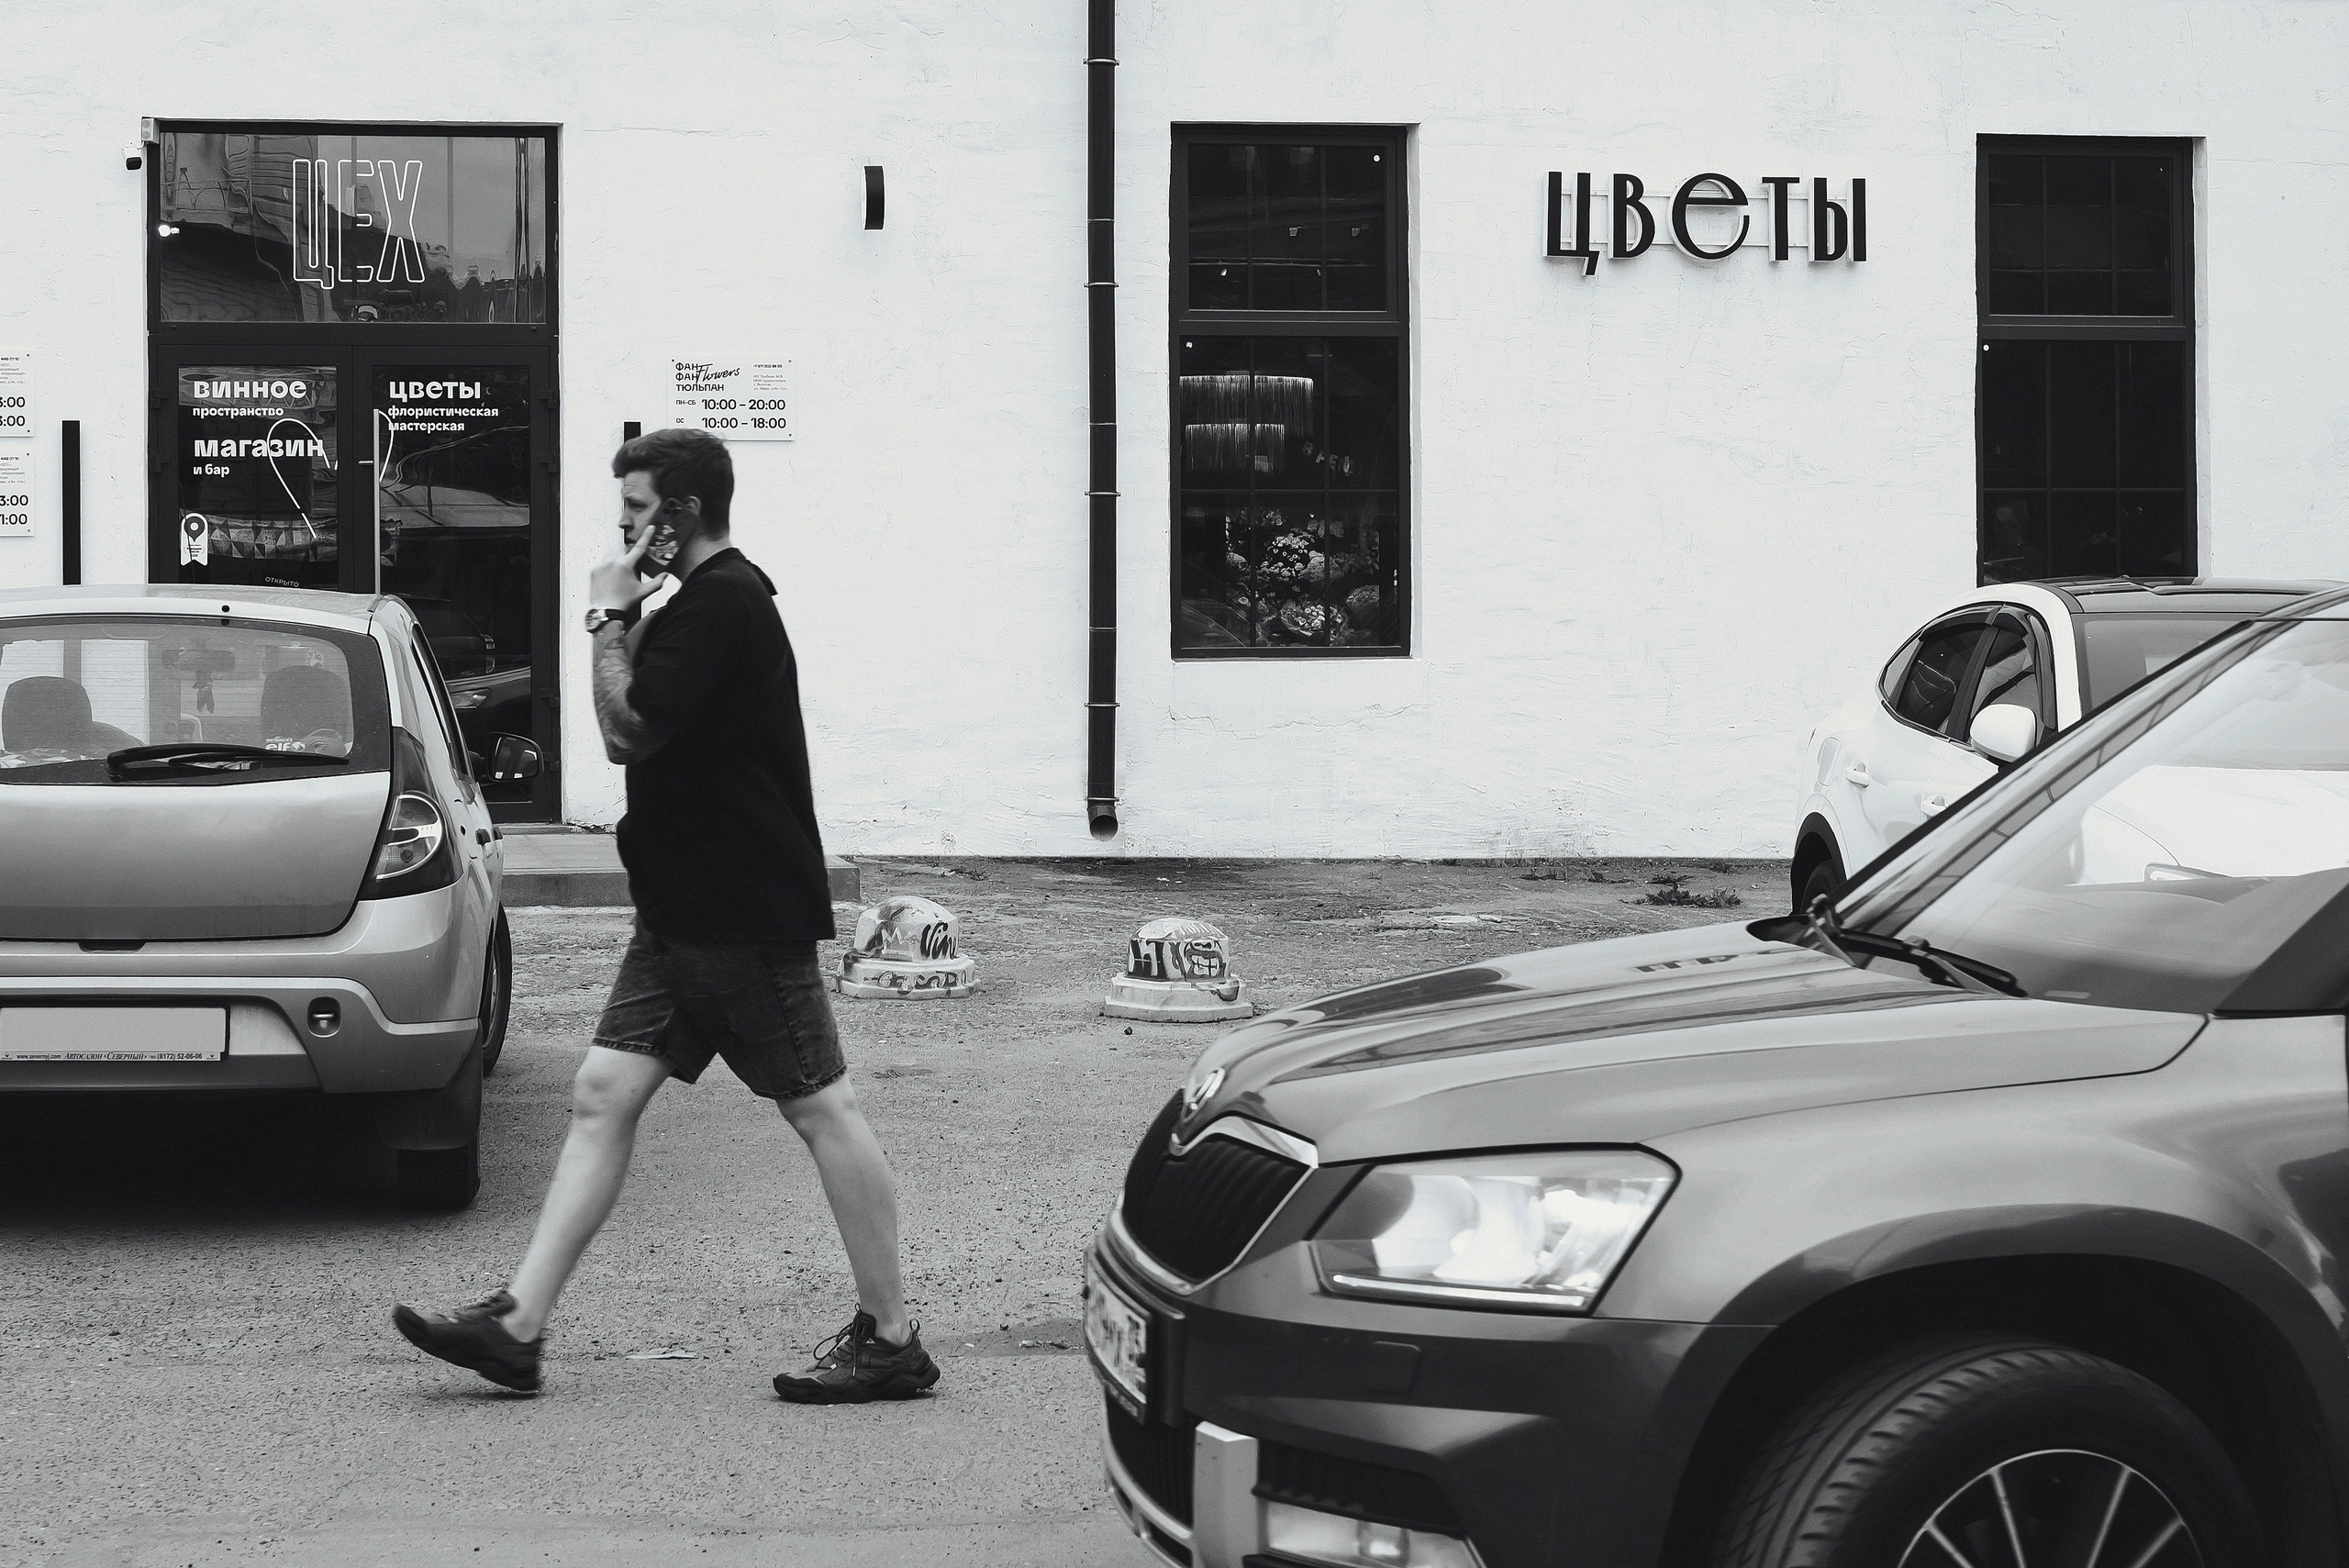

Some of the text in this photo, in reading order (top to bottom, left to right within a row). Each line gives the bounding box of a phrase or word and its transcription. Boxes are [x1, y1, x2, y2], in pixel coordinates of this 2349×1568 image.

[293, 159, 425, 289] ЦЕХ
[696, 363, 740, 384] Flowers
[194, 381, 306, 398] винное
[389, 381, 481, 403] цветы
[675, 384, 725, 392] ТЮЛЬПАН
[702, 398, 737, 410] 10:00
[748, 399, 786, 410] 20:00
[193, 407, 284, 418] пространство
[388, 405, 499, 419] флористическая
[388, 422, 465, 434] мастерская
[702, 417, 738, 428] 10:00
[751, 417, 786, 428] 18:00
[194, 439, 323, 457] магазин
[193, 463, 230, 478] и бар
[264, 576, 300, 587] ОТКРЫТО
[265, 742, 291, 751] elf
